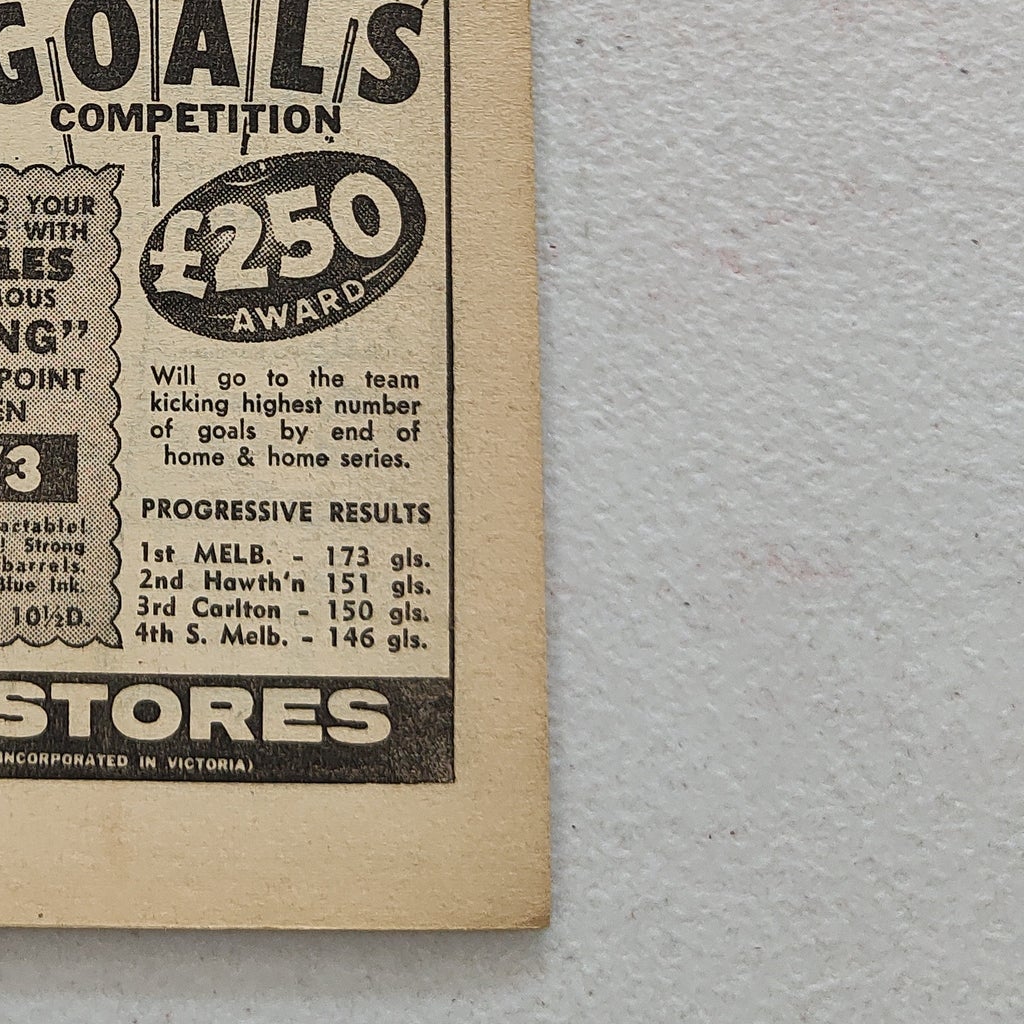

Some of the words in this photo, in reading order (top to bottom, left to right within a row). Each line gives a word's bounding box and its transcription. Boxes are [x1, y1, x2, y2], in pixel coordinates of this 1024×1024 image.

[50, 102, 341, 134] COMPETITION
[26, 194, 95, 216] YOUR
[24, 221, 89, 242] WITH
[150, 173, 402, 298] £250
[232, 280, 365, 332] AWARD
[151, 365, 195, 385] Will
[218, 373, 245, 390] go
[267, 370, 288, 386] to
[310, 366, 343, 387] the
[365, 371, 419, 389] team
[151, 391, 228, 417] kicking
[243, 392, 322, 417] highest
[335, 394, 421, 415] number
[151, 418, 173, 438] of
[198, 418, 256, 443] goals
[281, 419, 308, 444] by
[332, 420, 374, 441] end
[397, 420, 420, 442] of
[165, 444, 224, 466] home
[238, 447, 254, 466] &
[268, 445, 329, 467] home
[341, 448, 410, 468] series.
[142, 498, 311, 522] PROGRESSIVE
[330, 502, 430, 524] RESULTS
[24, 539, 85, 556] Strong
[142, 542, 175, 562] 1st
[194, 543, 271, 564] MELB.
[327, 546, 369, 566] 173
[391, 548, 430, 571] gls.
[140, 569, 183, 589] 2nd
[205, 570, 304, 592] Hawth'n
[328, 573, 367, 594] 151
[392, 575, 430, 598] gls.
[138, 596, 175, 616] 3rd
[192, 597, 280, 619] Carlton
[329, 600, 373, 621] 150
[389, 601, 429, 625] gls.
[136, 623, 173, 643] 4th
[187, 624, 206, 644] S.
[221, 624, 287, 646] Melb.
[330, 627, 374, 648] 146
[388, 628, 427, 653] gls.
[140, 756, 156, 769] IN
[167, 757, 254, 773] VICTORIA)
